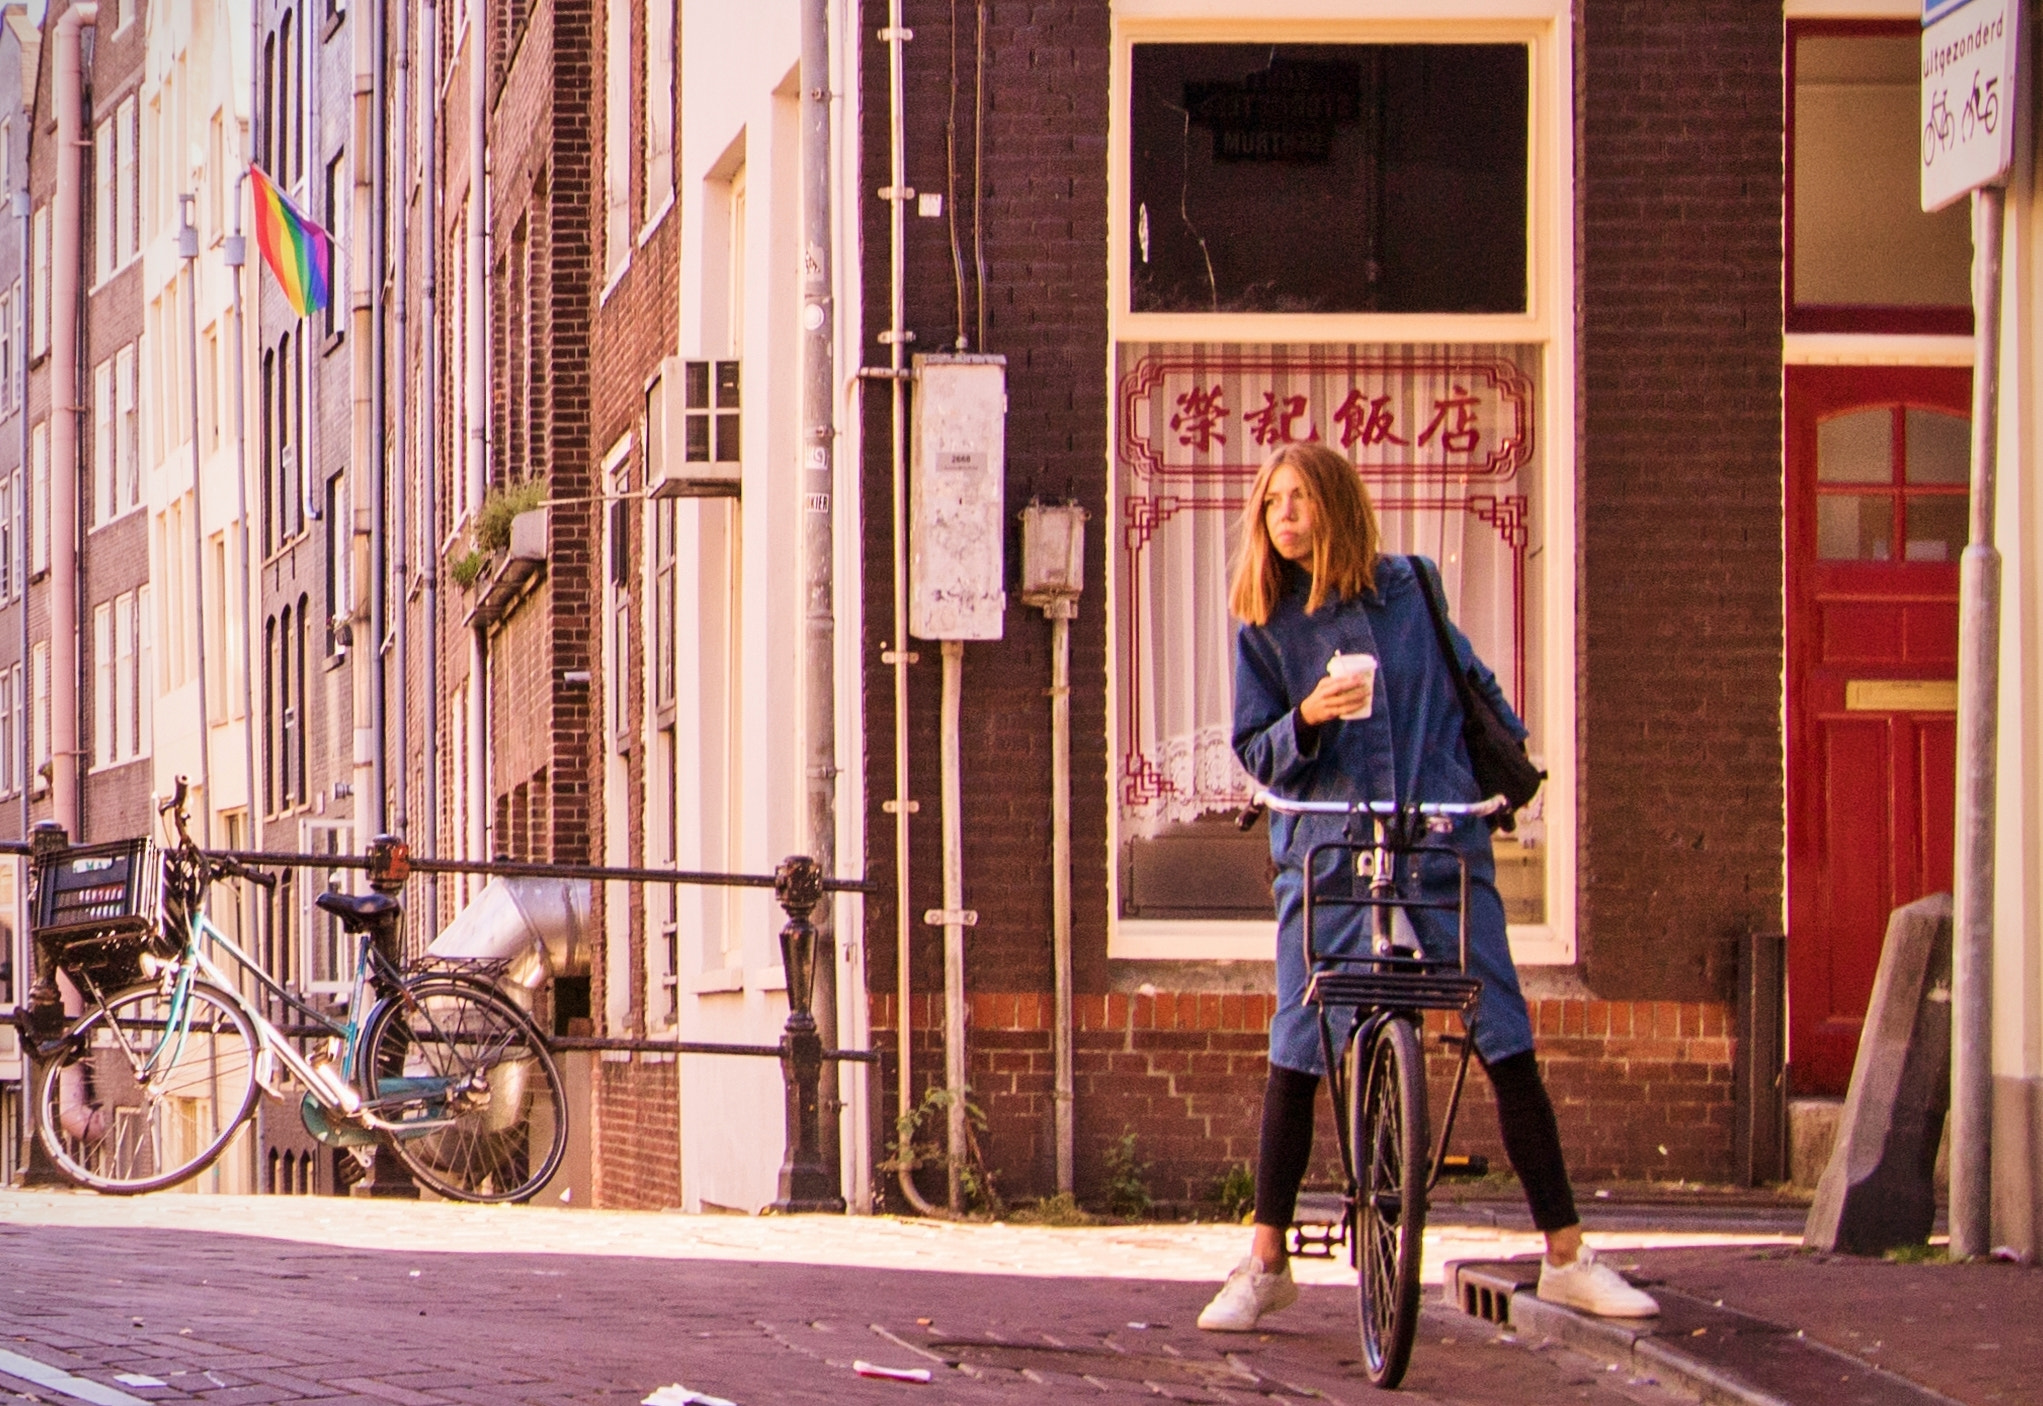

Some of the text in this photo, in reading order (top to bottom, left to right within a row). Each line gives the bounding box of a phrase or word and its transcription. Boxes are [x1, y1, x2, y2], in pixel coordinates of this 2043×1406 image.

[1923, 11, 2004, 77] uitgezonderd
[1170, 384, 1481, 453] 榮記飯店
